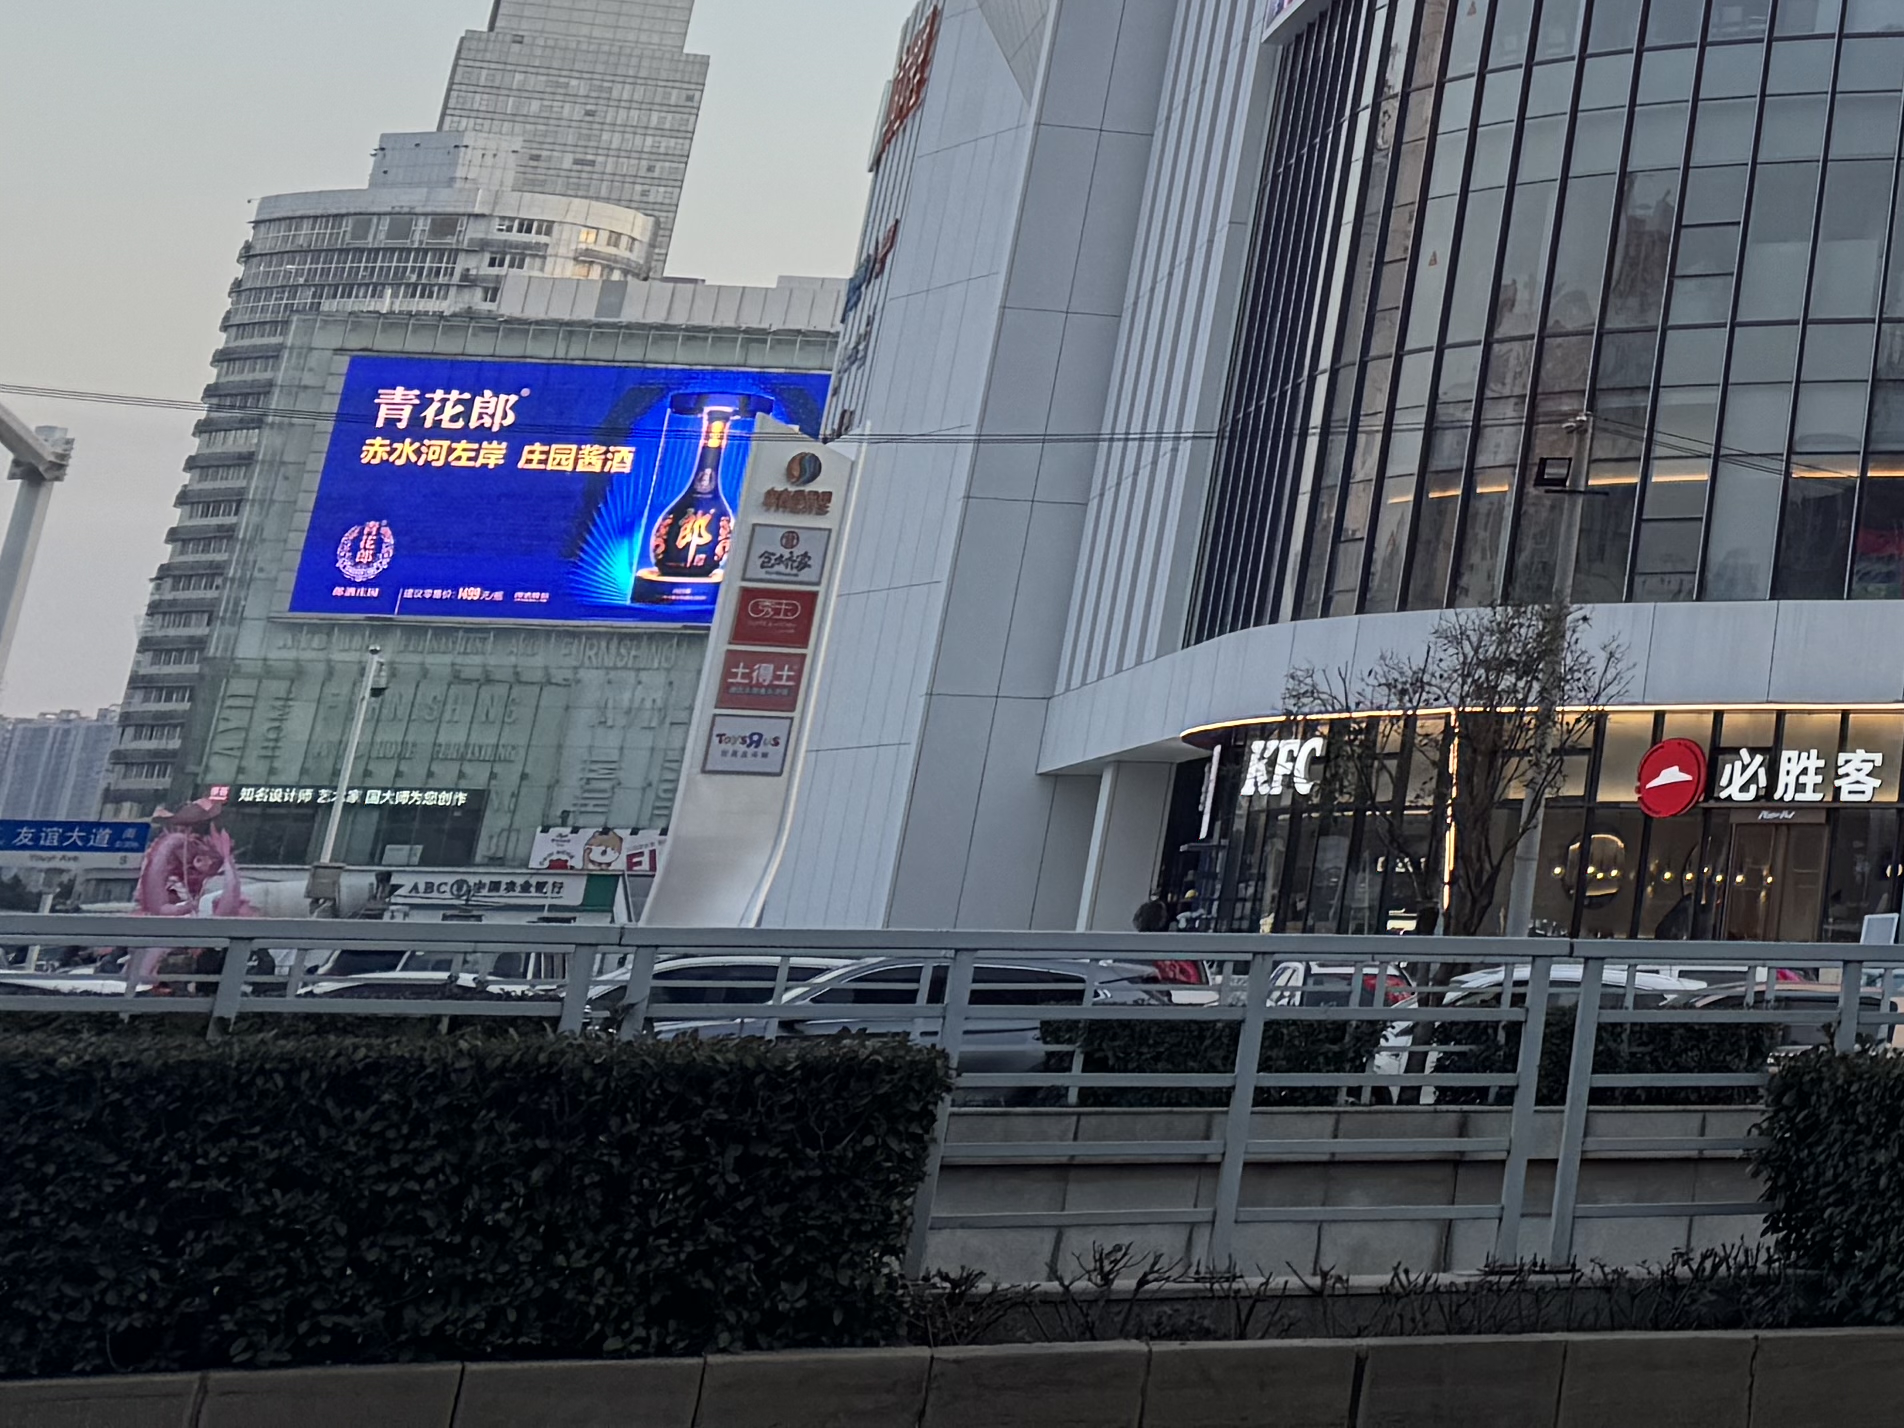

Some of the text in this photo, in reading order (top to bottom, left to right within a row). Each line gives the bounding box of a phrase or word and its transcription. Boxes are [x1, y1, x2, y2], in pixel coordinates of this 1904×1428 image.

[373, 386, 519, 432] 青花郎
[360, 436, 637, 475] 赤水河左岸 庄园酱酒
[676, 511, 713, 568] 郎
[727, 662, 797, 687] 土得土
[1240, 737, 1324, 796] KFC
[1719, 748, 1883, 802] 必胜客
[238, 787, 313, 805] 知名设计师
[364, 789, 468, 807] 国大师为您创作
[14, 826, 111, 849] 友谊大道
[409, 880, 448, 895] ABC
[473, 880, 564, 896] 中国农业银行
